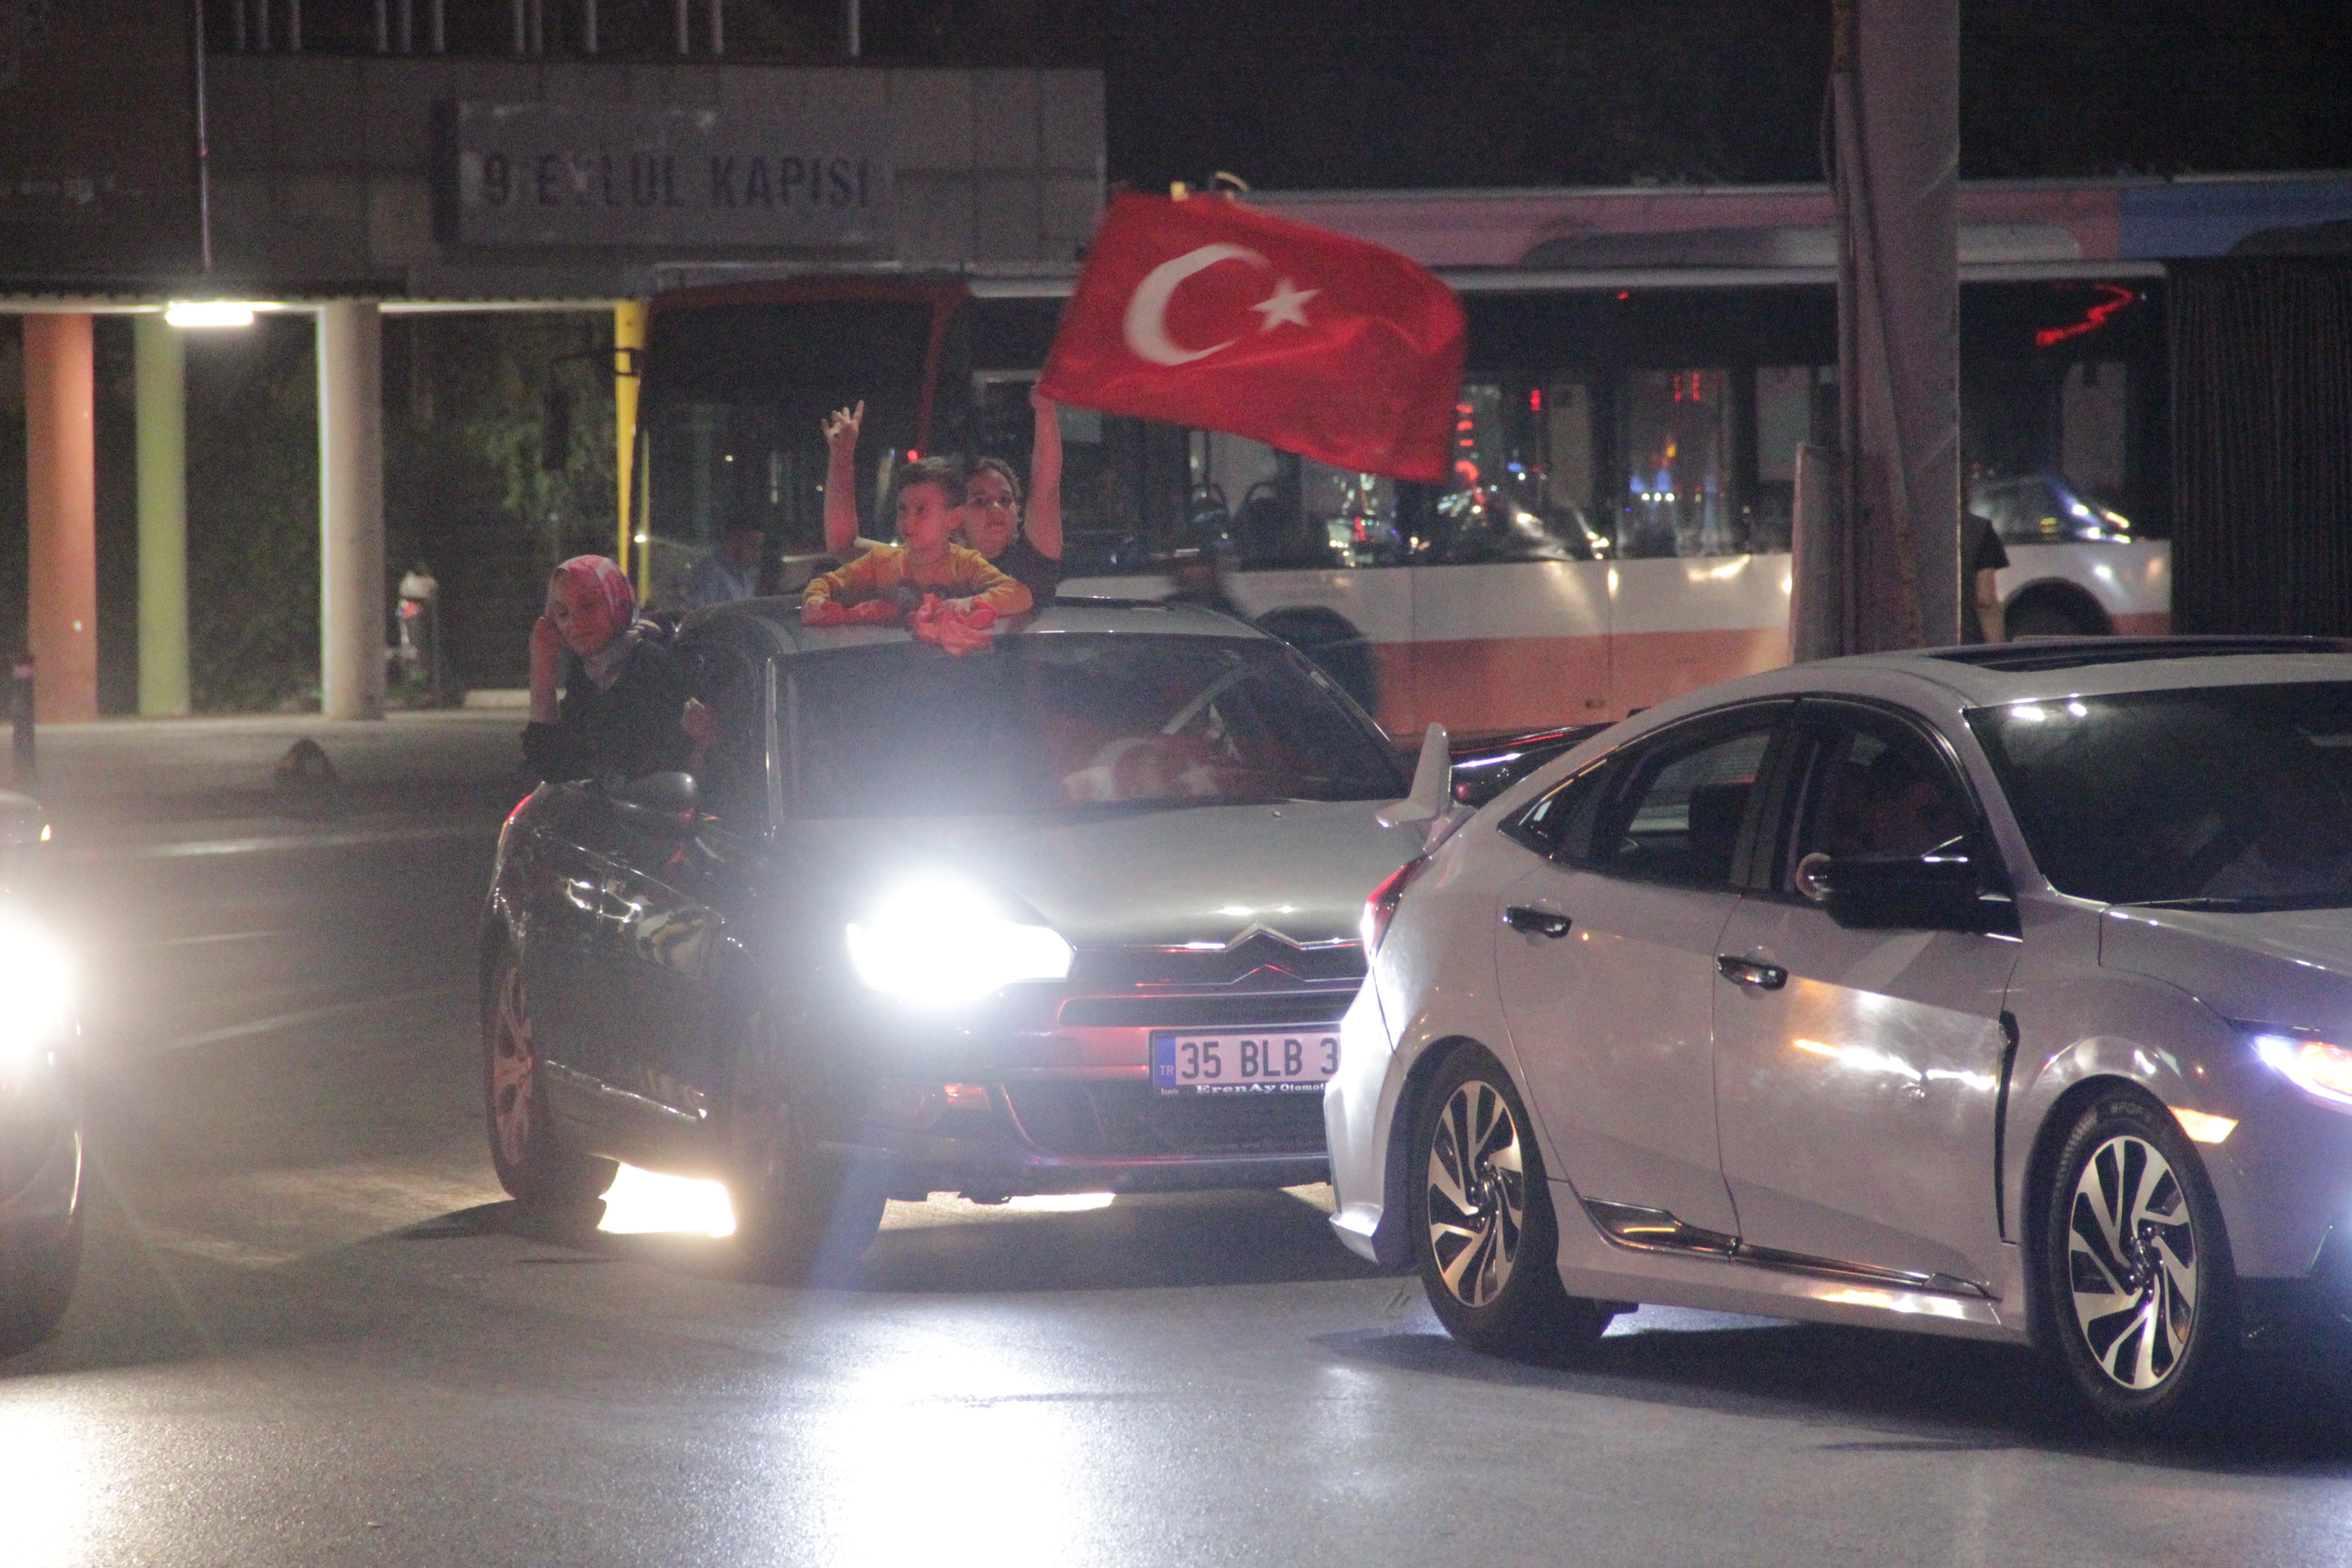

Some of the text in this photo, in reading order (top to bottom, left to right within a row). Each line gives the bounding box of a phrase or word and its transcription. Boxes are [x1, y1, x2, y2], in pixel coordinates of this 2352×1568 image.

[484, 151, 511, 207] 9
[711, 154, 869, 208] KAPISI
[1160, 1065, 1174, 1075] TR
[1181, 1041, 1221, 1079] 35
[1240, 1039, 1303, 1078] BLB
[1196, 1082, 1328, 1095] ErenAy Otomot
